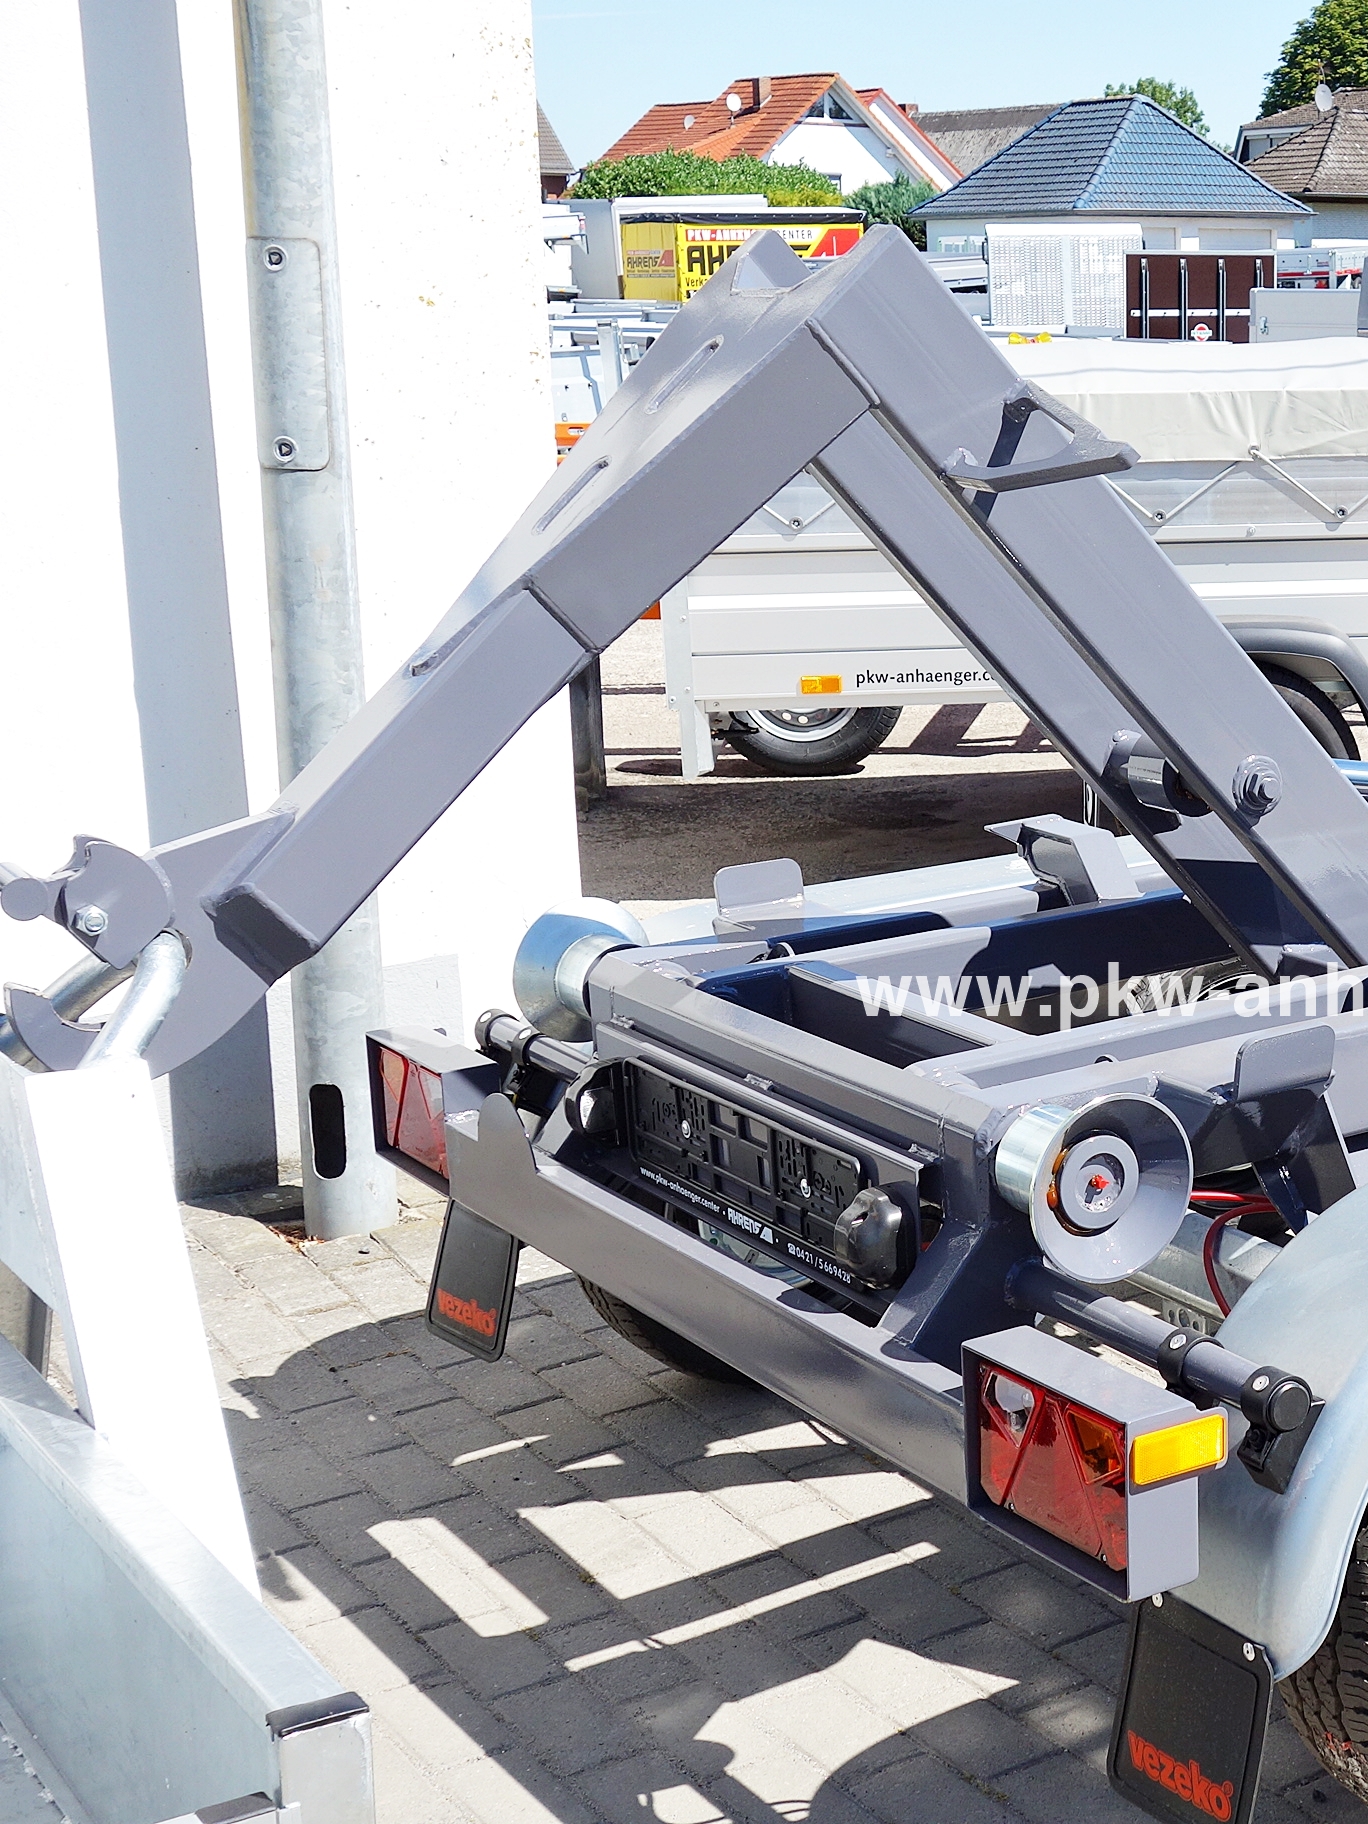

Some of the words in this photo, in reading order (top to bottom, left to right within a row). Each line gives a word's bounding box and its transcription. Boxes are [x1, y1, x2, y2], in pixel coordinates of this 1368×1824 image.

[777, 229, 813, 240] ENTER
[627, 256, 660, 269] AHRENS
[639, 1166, 720, 1213] www.pkw-anhaenger.center
[727, 1207, 762, 1235] AHRENS
[437, 1288, 497, 1337] vezeko
[1128, 1729, 1233, 1822] vezeko
